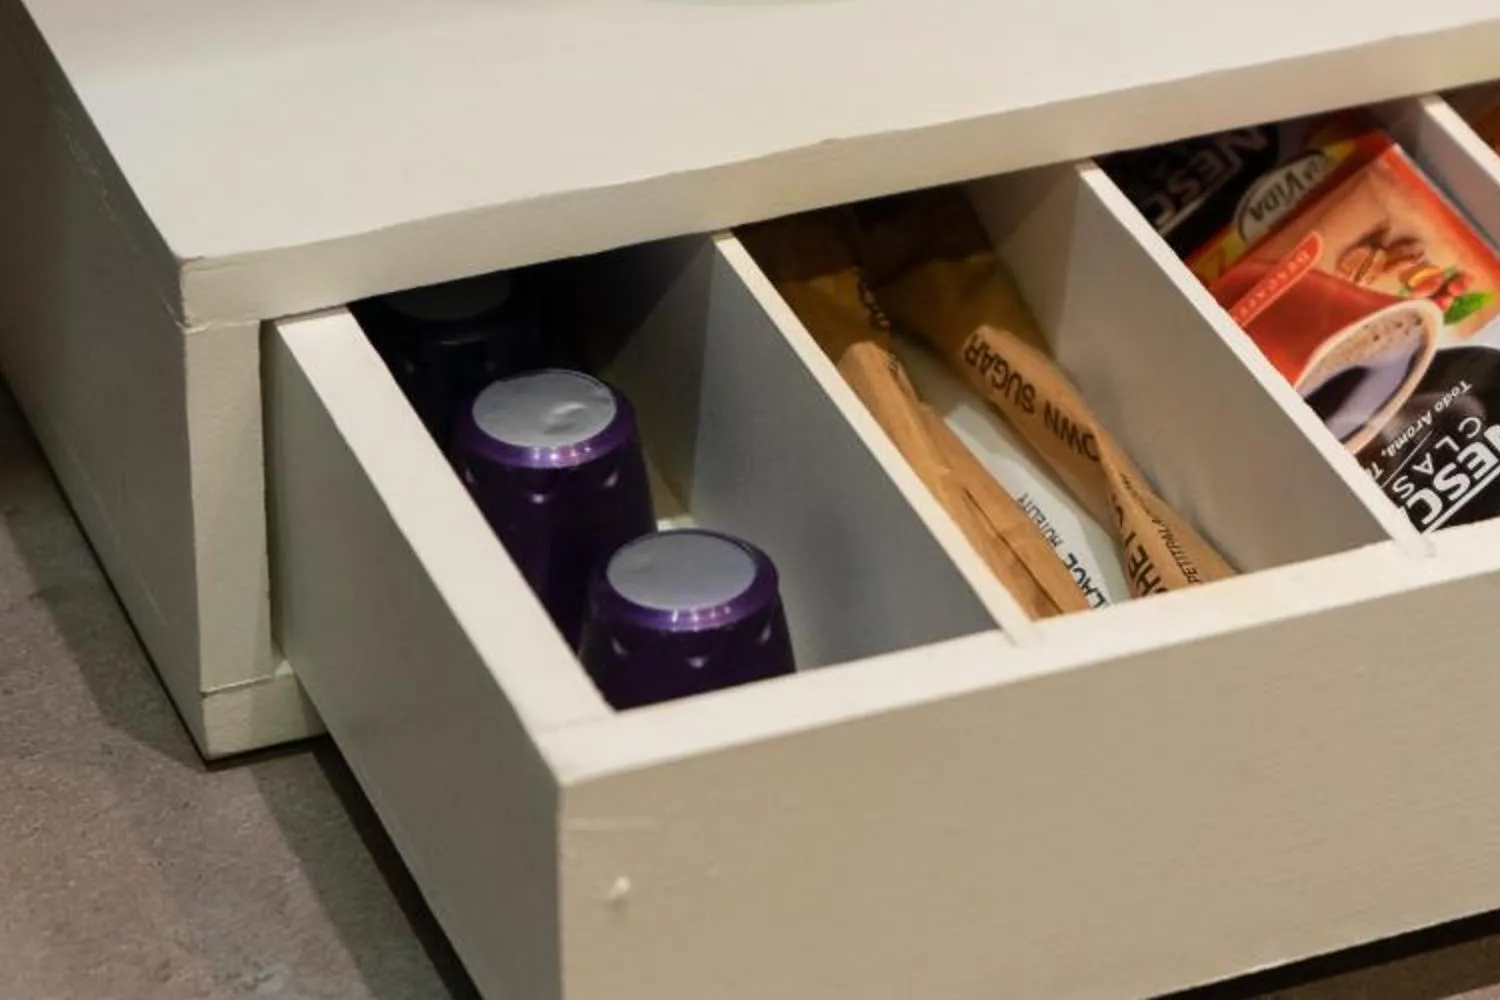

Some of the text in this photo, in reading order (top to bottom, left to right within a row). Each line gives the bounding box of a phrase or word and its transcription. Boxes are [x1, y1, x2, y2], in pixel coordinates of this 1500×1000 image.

[964, 333, 1037, 415] SUGAR
[1433, 379, 1473, 413] Todo
[1380, 410, 1433, 458] Aroma,
[1391, 416, 1482, 499] CLAS
